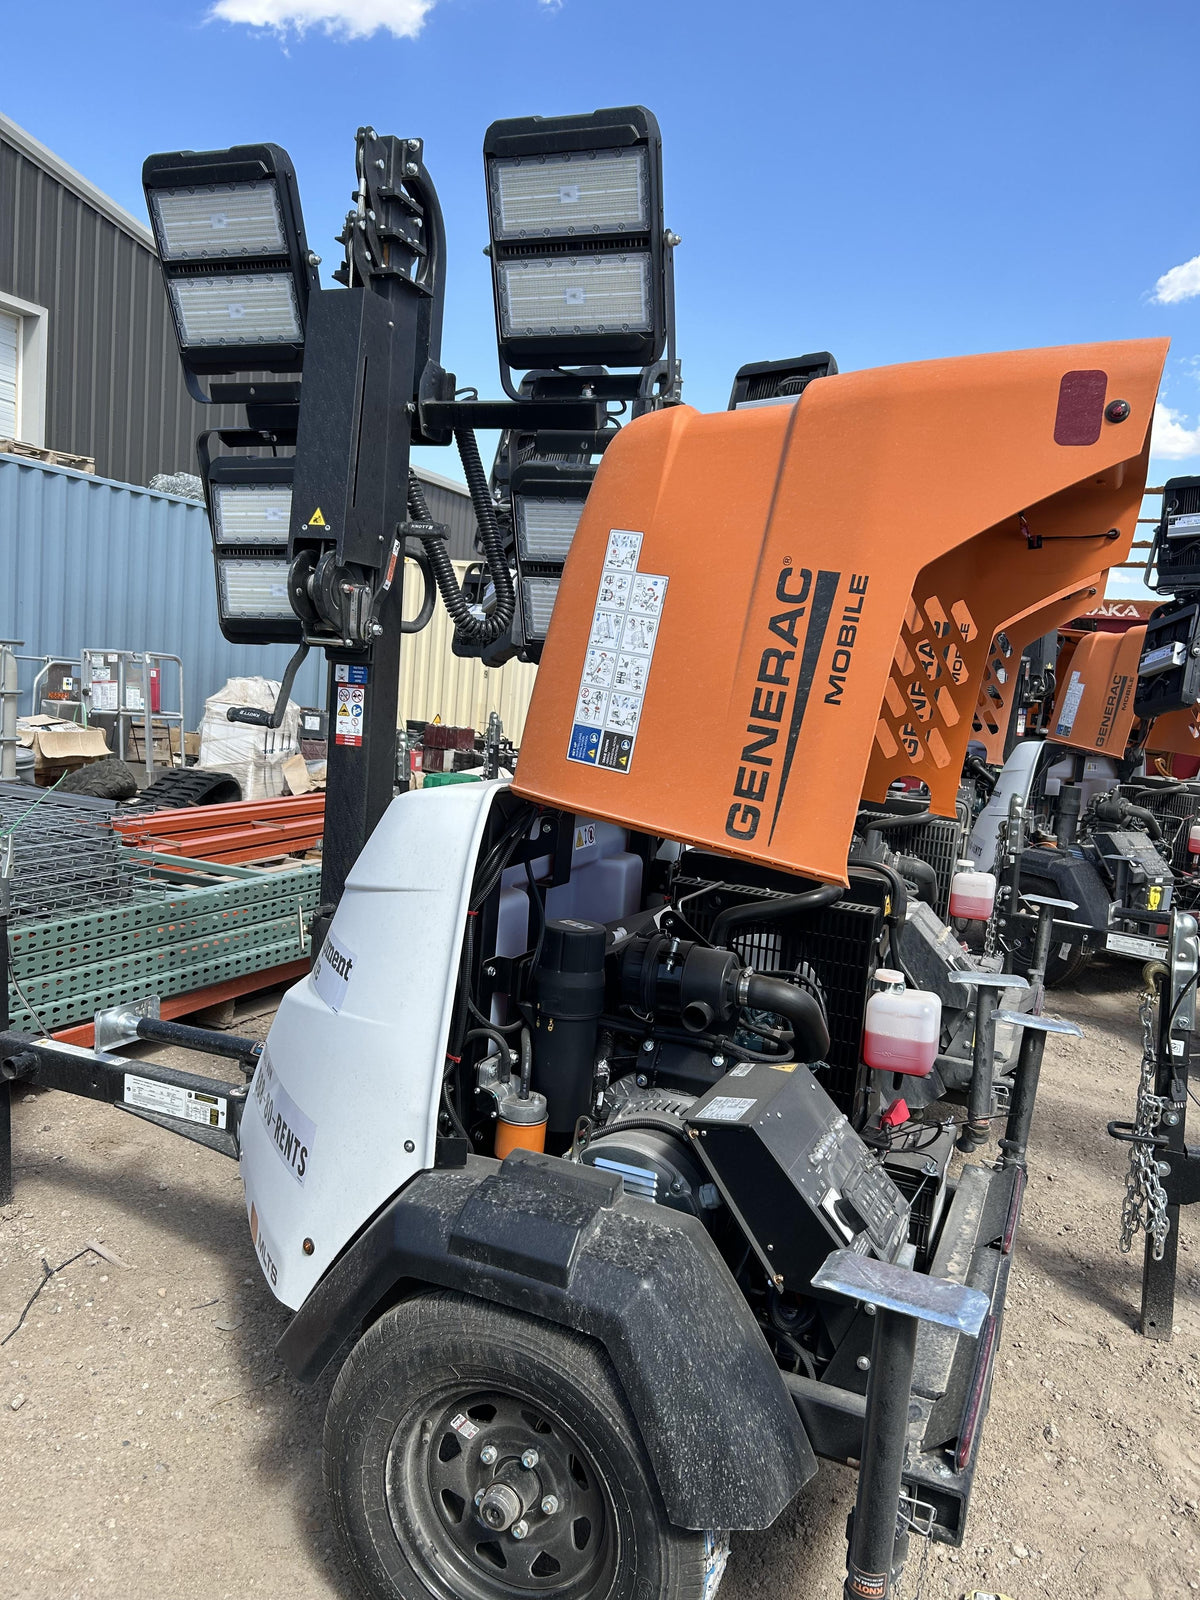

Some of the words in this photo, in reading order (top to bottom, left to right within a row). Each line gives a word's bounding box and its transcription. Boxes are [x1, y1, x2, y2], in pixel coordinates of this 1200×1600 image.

[824, 573, 869, 706] MOBILE
[1095, 674, 1122, 747] GENERAC
[1121, 677, 1135, 711] MOBILE
[257, 1231, 279, 1287] MLTS
[852, 1580, 883, 1594] KNOTT
